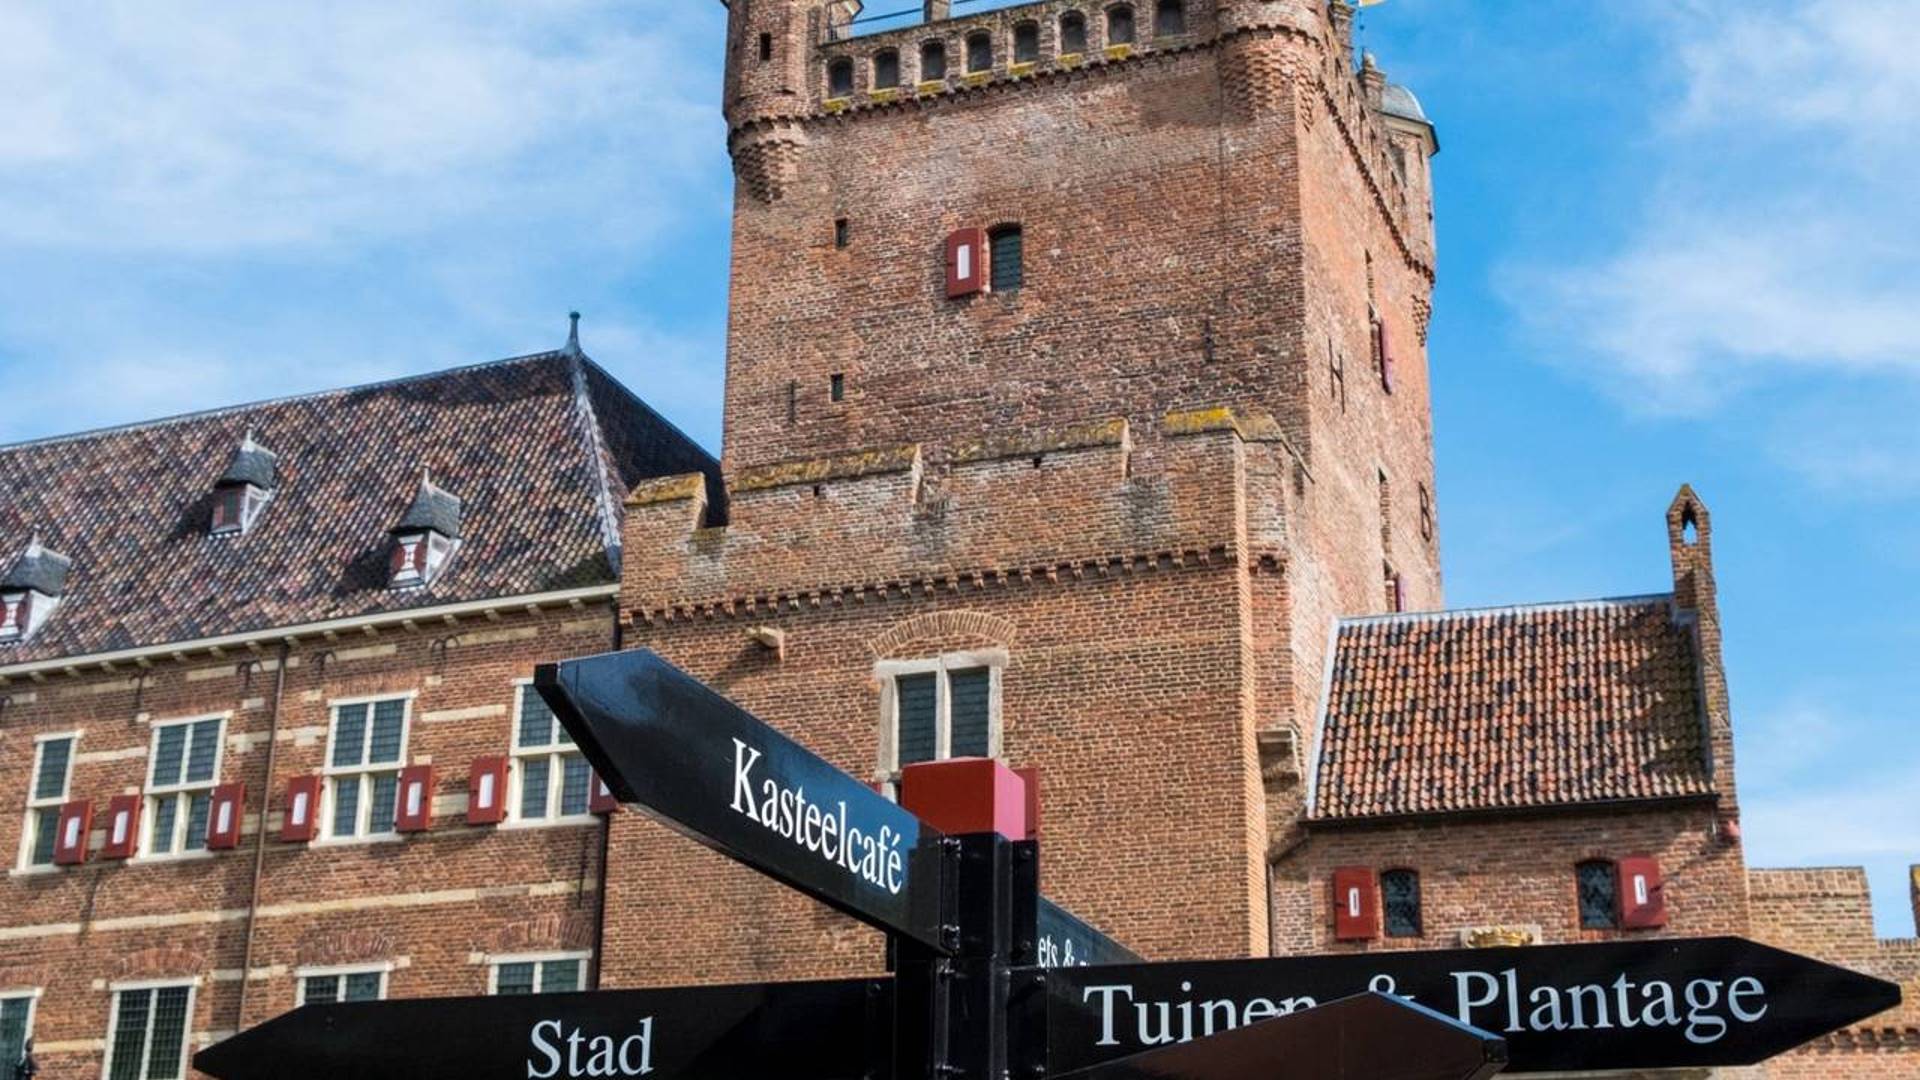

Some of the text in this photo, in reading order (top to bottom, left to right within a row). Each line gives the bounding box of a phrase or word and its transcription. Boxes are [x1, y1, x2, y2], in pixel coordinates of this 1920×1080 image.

[730, 737, 902, 895] Kasteelcafé
[1449, 967, 1769, 1044] Plantage
[527, 1016, 655, 1078] Stad
